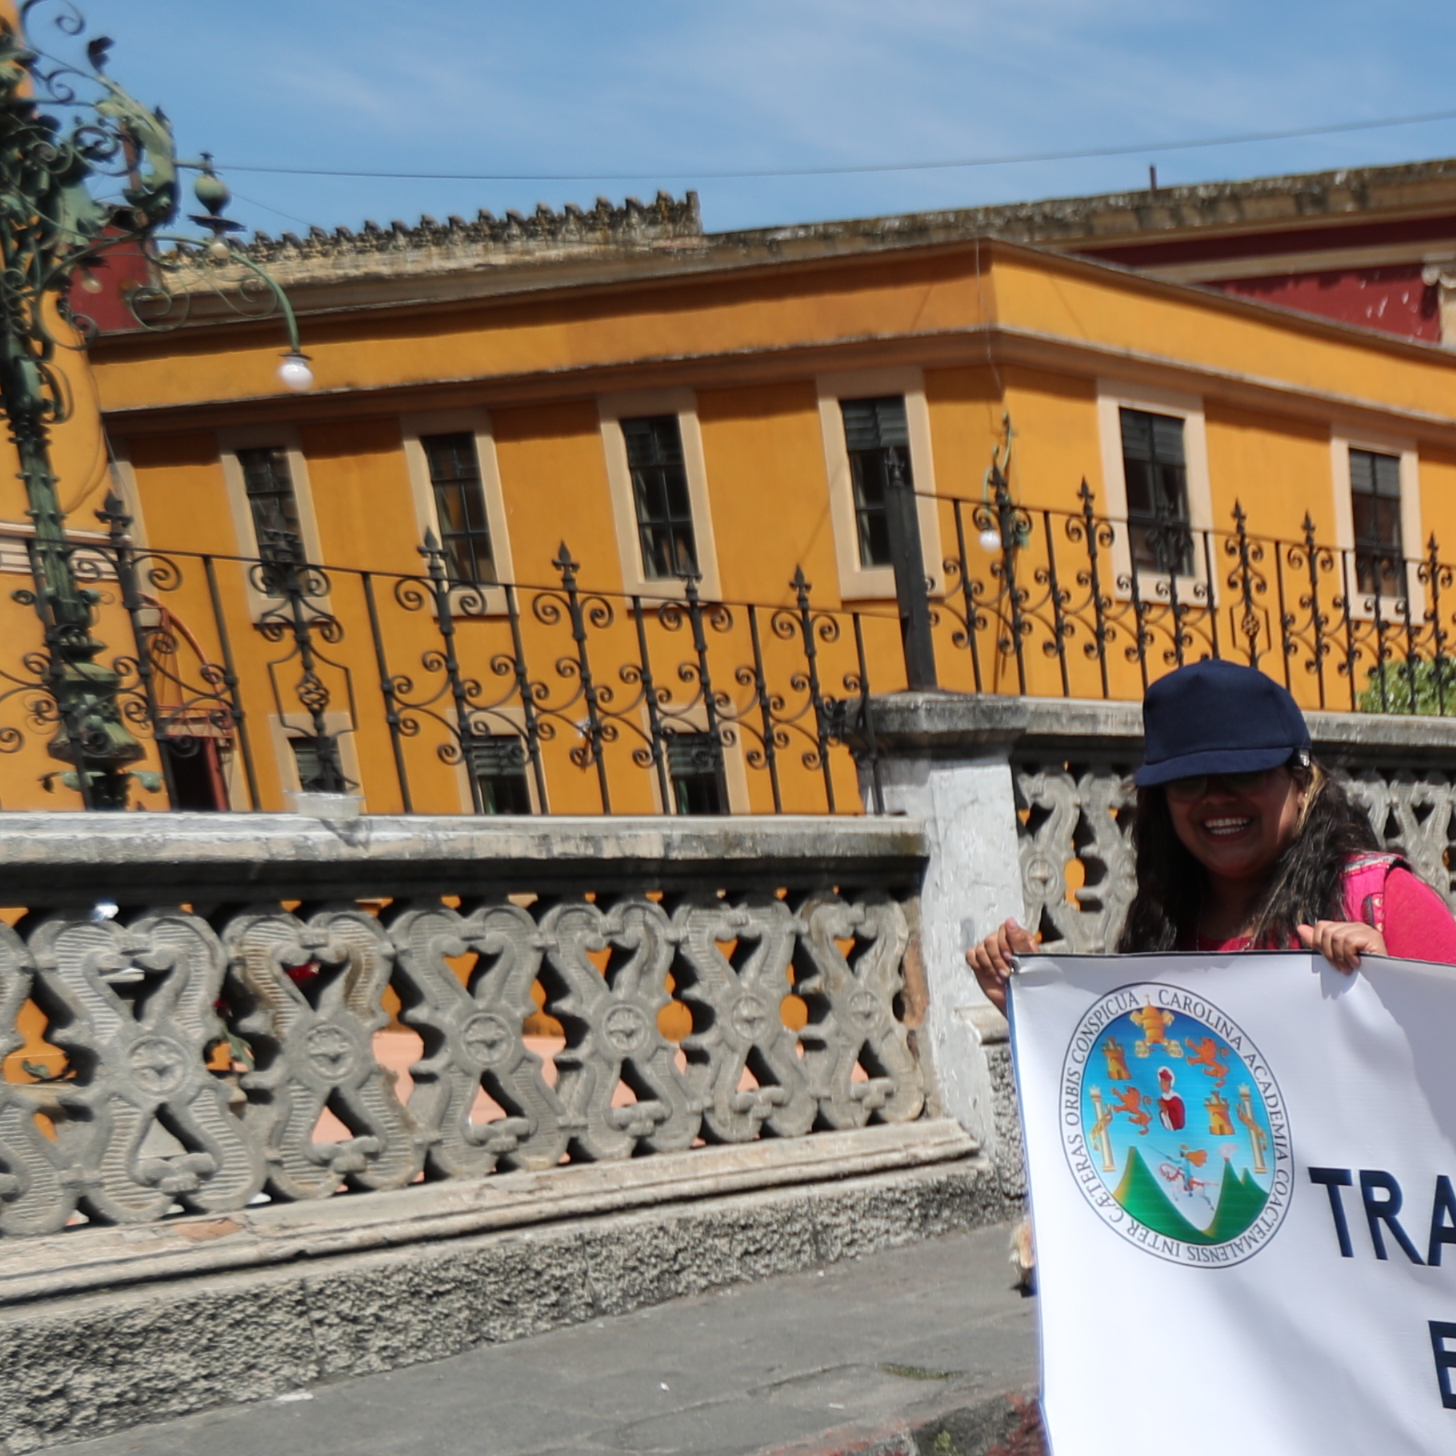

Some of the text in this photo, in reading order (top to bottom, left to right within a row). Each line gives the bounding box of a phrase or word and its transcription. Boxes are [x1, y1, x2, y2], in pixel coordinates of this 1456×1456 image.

[1071, 990, 1140, 1065] CONSPICUA
[1158, 989, 1244, 1051] CAROLINA
[1064, 1068, 1082, 1127] ORBIS
[1243, 1052, 1289, 1161] ACADEMIA
[1126, 1219, 1181, 1257] INTER
